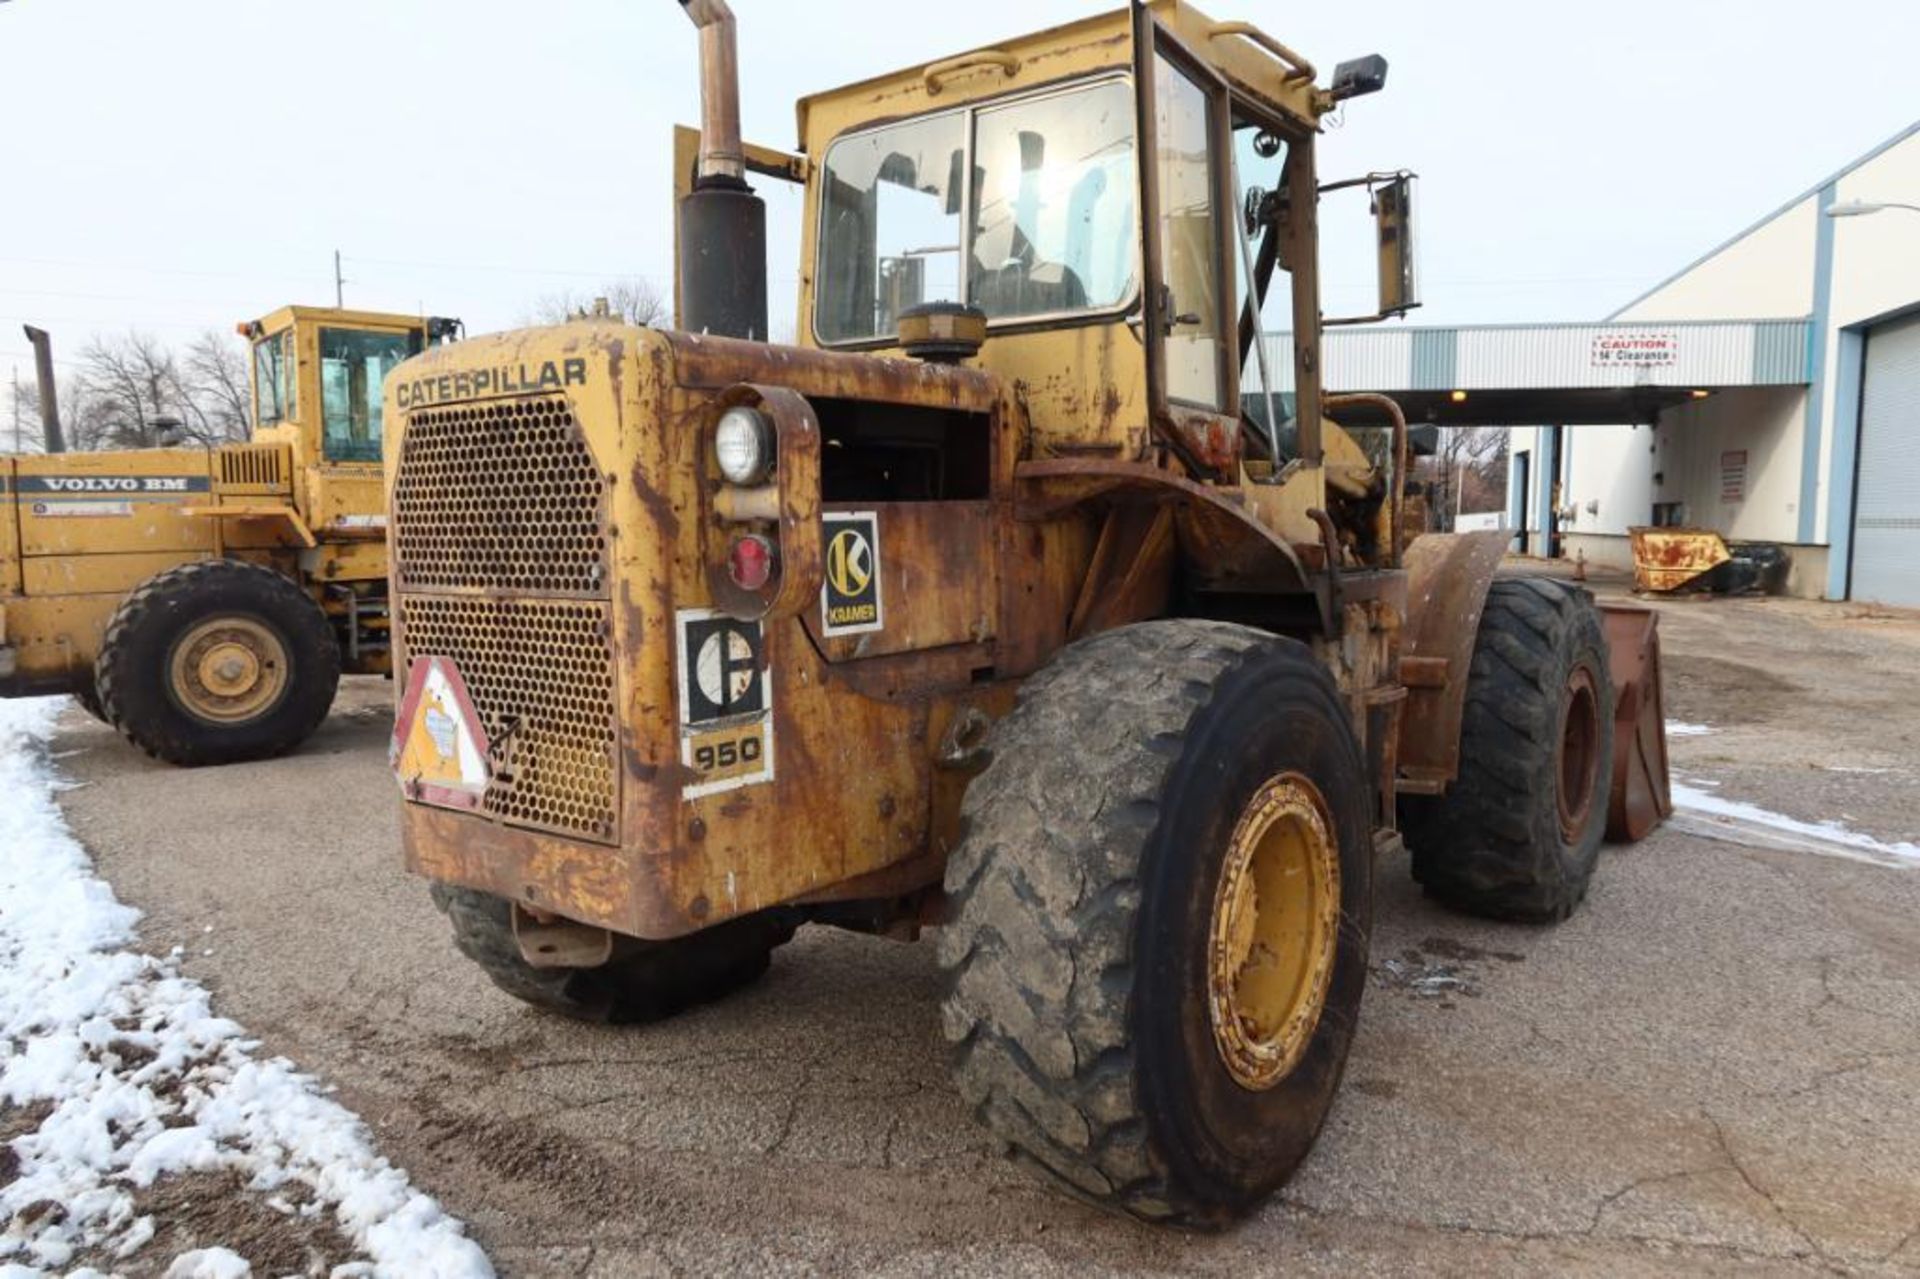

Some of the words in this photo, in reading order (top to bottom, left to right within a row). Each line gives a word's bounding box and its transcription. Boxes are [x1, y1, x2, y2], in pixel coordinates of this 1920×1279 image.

[1601, 340, 1667, 349] CAUTION
[1616, 350, 1669, 360] Clearance
[395, 357, 587, 408] CATERPILLAR
[42, 477, 139, 491] VOLVO
[143, 477, 188, 491] BM
[828, 604, 876, 624] KRAMER
[695, 737, 761, 771] 950
